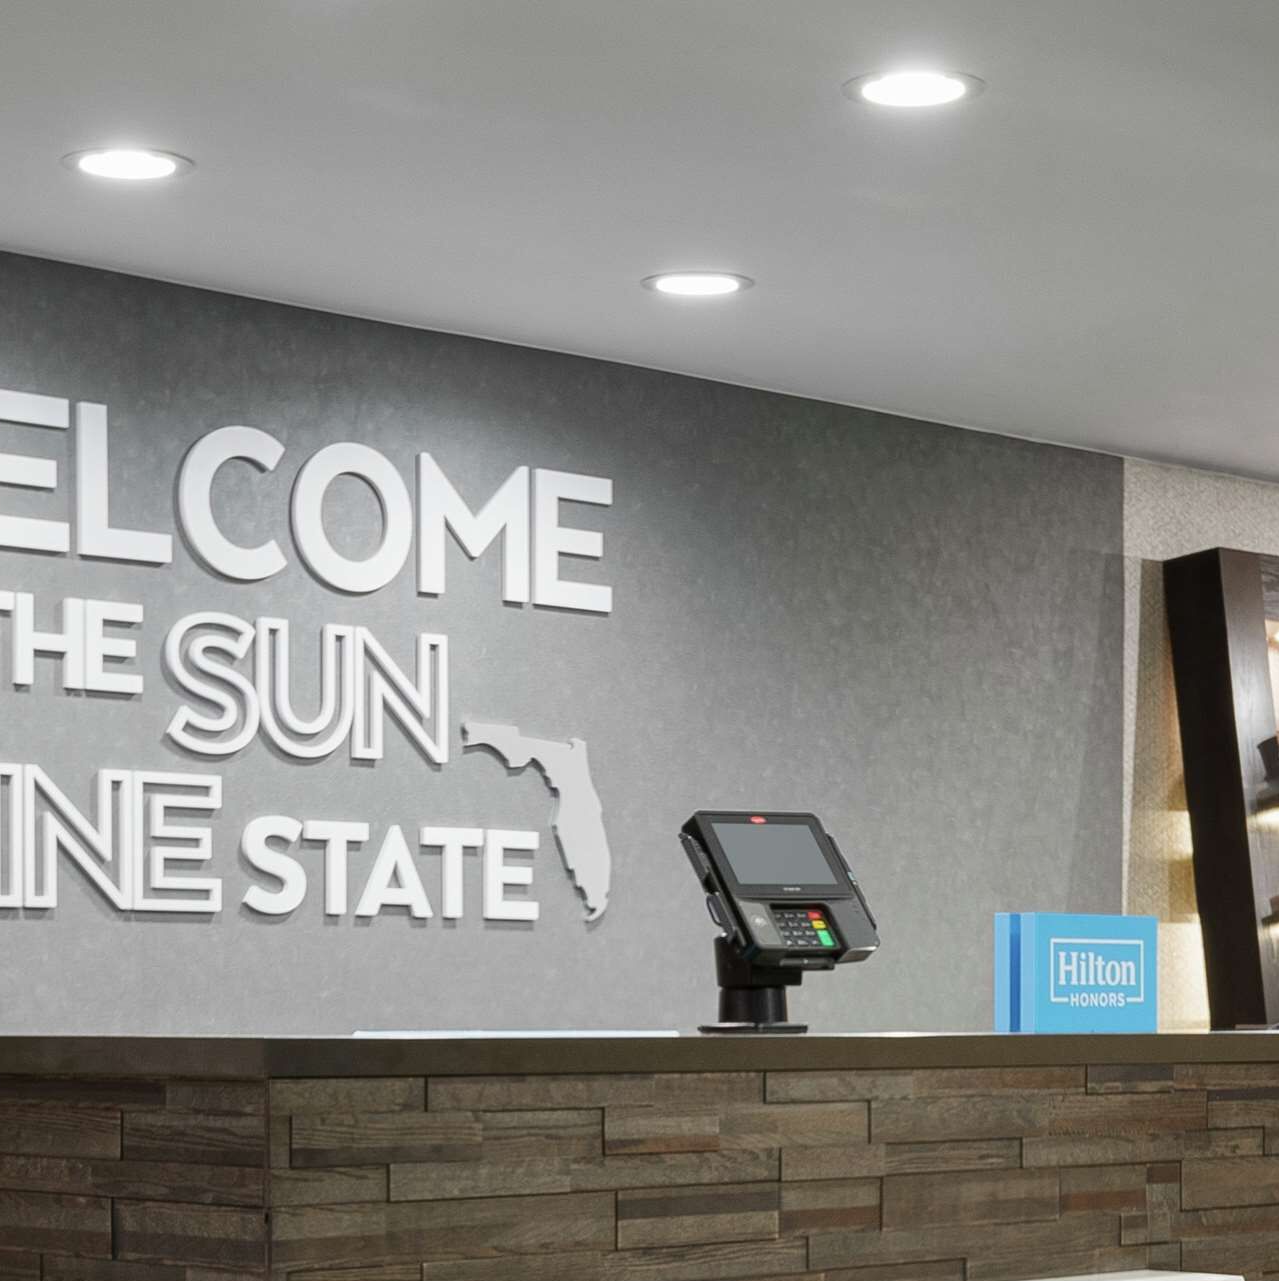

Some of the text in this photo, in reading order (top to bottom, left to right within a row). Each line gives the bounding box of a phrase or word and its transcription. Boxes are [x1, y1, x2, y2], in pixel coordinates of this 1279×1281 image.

[165, 612, 449, 764] SUN
[241, 816, 540, 921] STATE
[1058, 951, 1137, 986] Hilton
[1070, 992, 1126, 1008] HONORS
